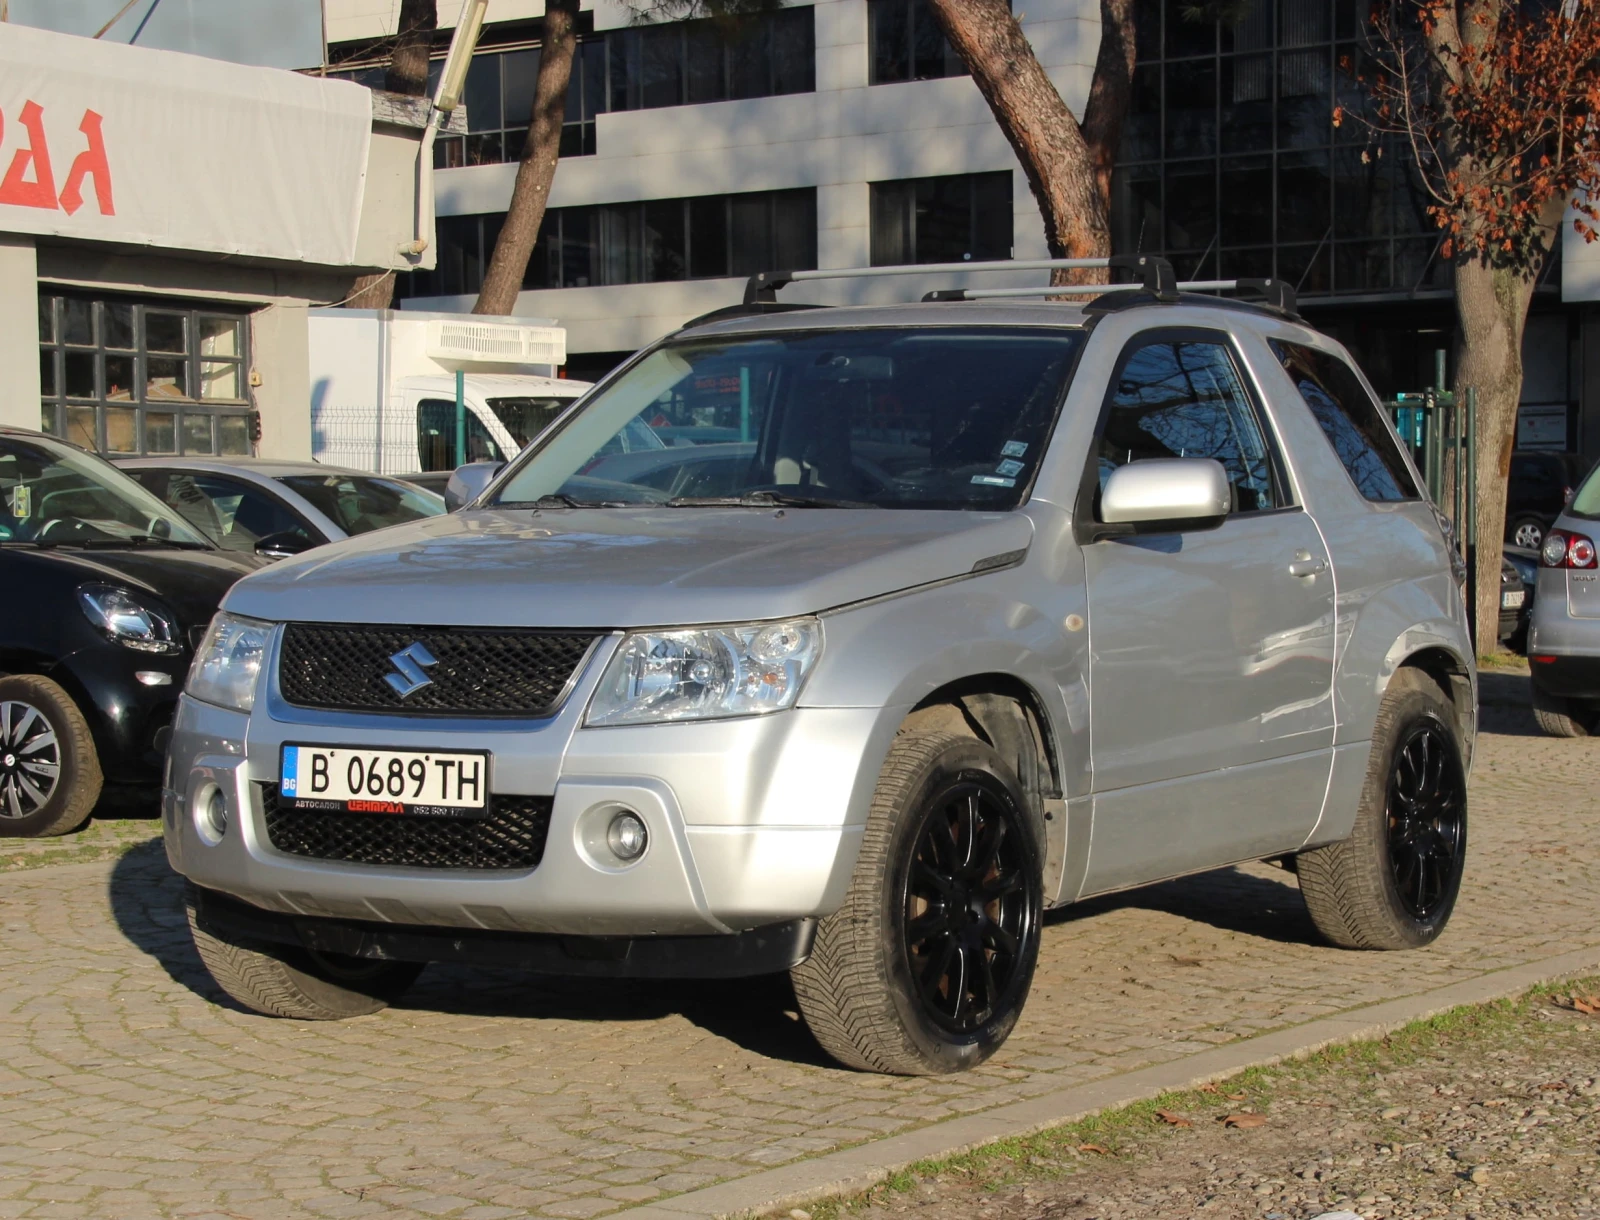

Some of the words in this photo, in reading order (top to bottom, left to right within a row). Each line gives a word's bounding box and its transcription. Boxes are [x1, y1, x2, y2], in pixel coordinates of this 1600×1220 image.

[0, 99, 115, 216] АЛ
[283, 778, 296, 790] BG
[311, 753, 329, 792] B
[347, 755, 426, 798] 0689
[435, 760, 479, 801] TH
[295, 800, 340, 810] АВТОСАЛОН
[413, 806, 429, 815] 052
